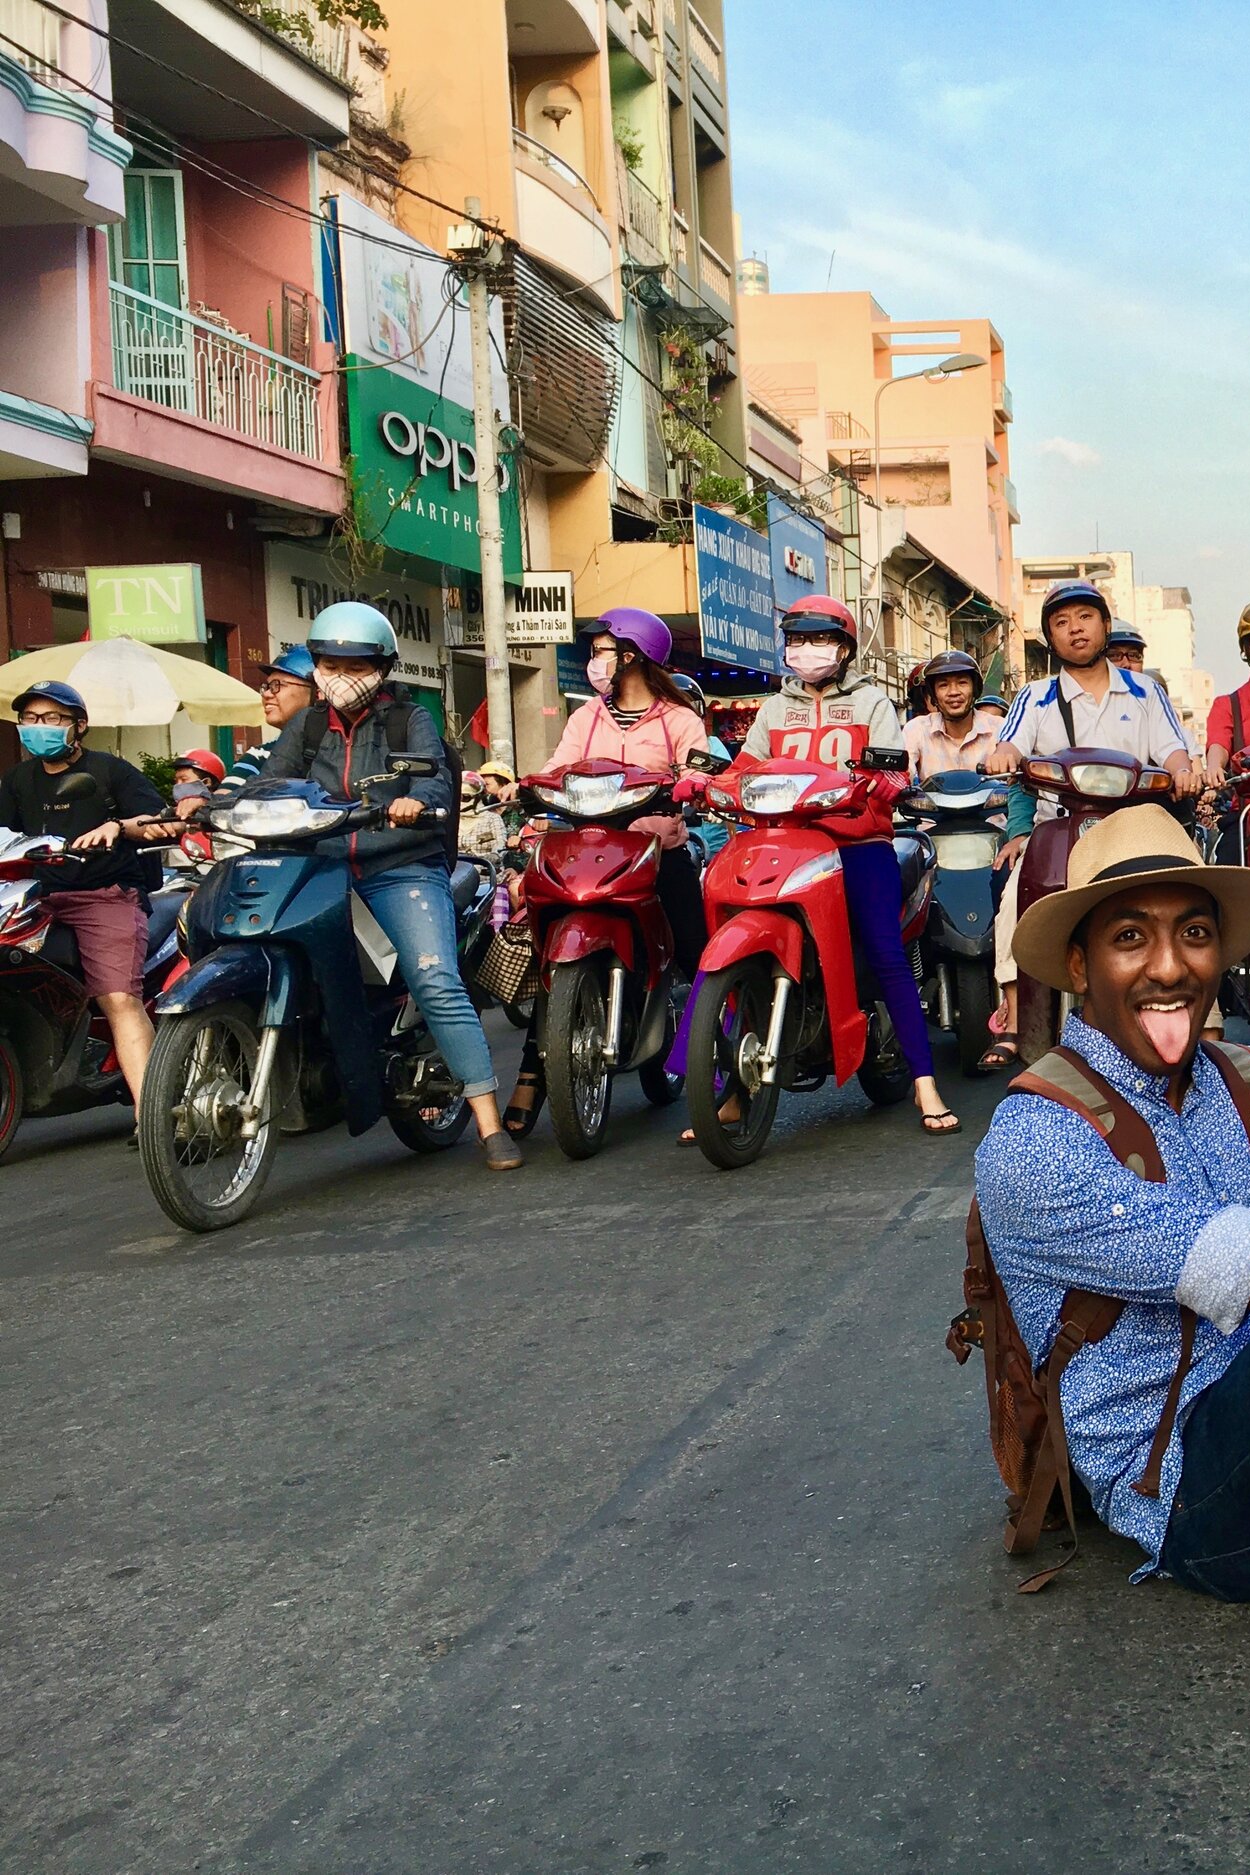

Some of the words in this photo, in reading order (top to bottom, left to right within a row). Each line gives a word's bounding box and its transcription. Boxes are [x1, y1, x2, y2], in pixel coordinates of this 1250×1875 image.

[697, 518, 717, 557] HÀNG
[718, 526, 734, 564] XUẤT
[95, 576, 184, 616] TN
[515, 586, 566, 612] MINH
[109, 623, 179, 638] Swimsuit
[466, 634, 484, 643] 356
